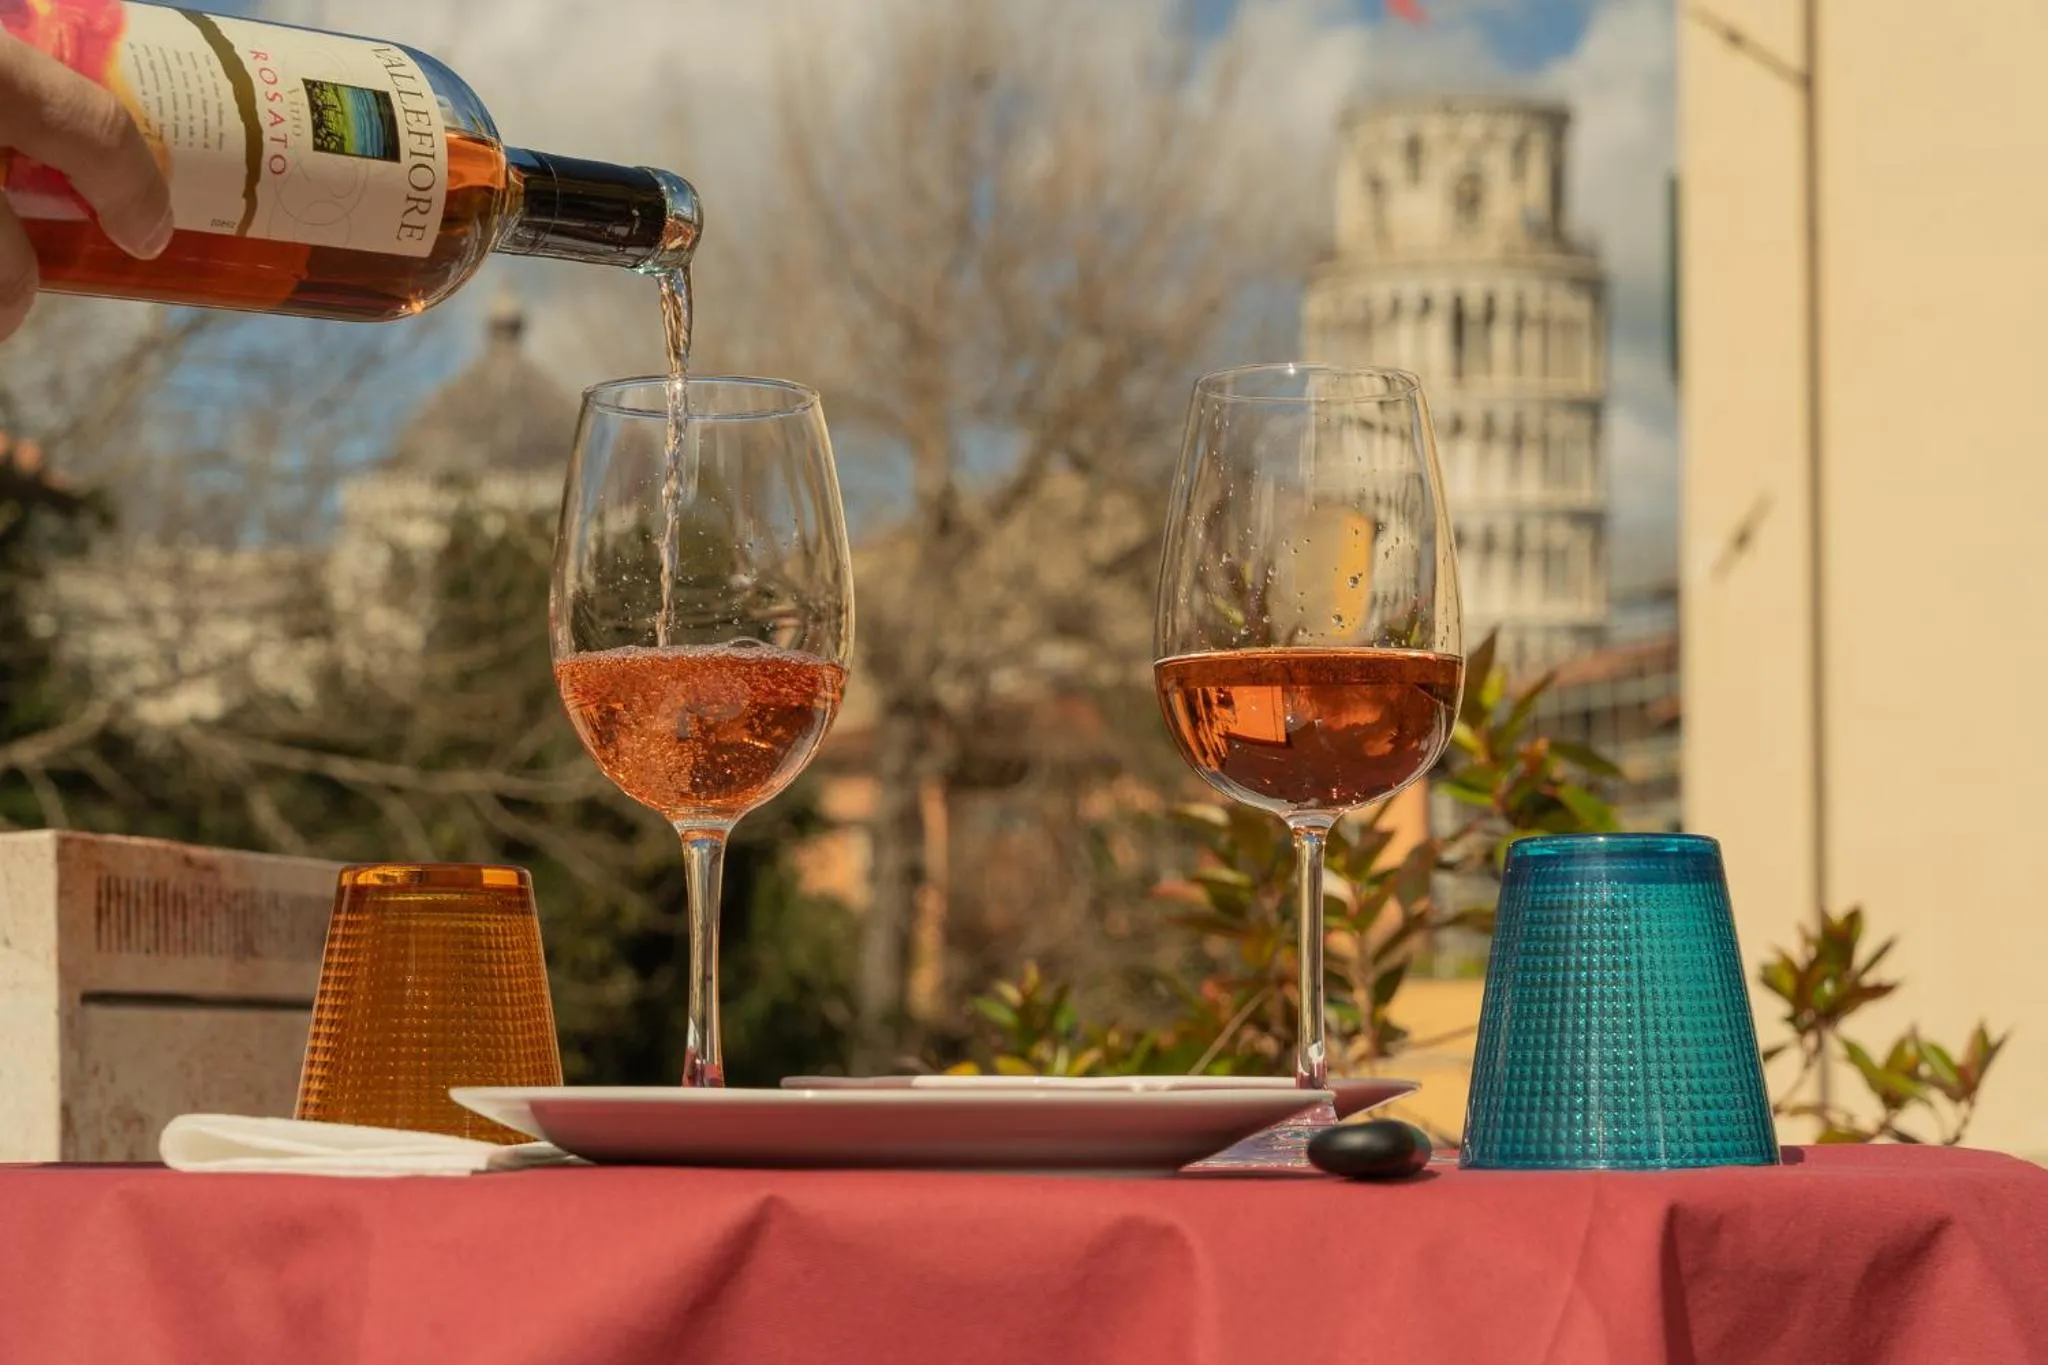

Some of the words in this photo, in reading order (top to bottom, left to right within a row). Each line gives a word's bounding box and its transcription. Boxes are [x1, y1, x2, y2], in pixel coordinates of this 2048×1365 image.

[250, 51, 287, 176] ROSATO
[288, 88, 304, 137] Vino
[372, 46, 437, 242] VALLEFIORE
